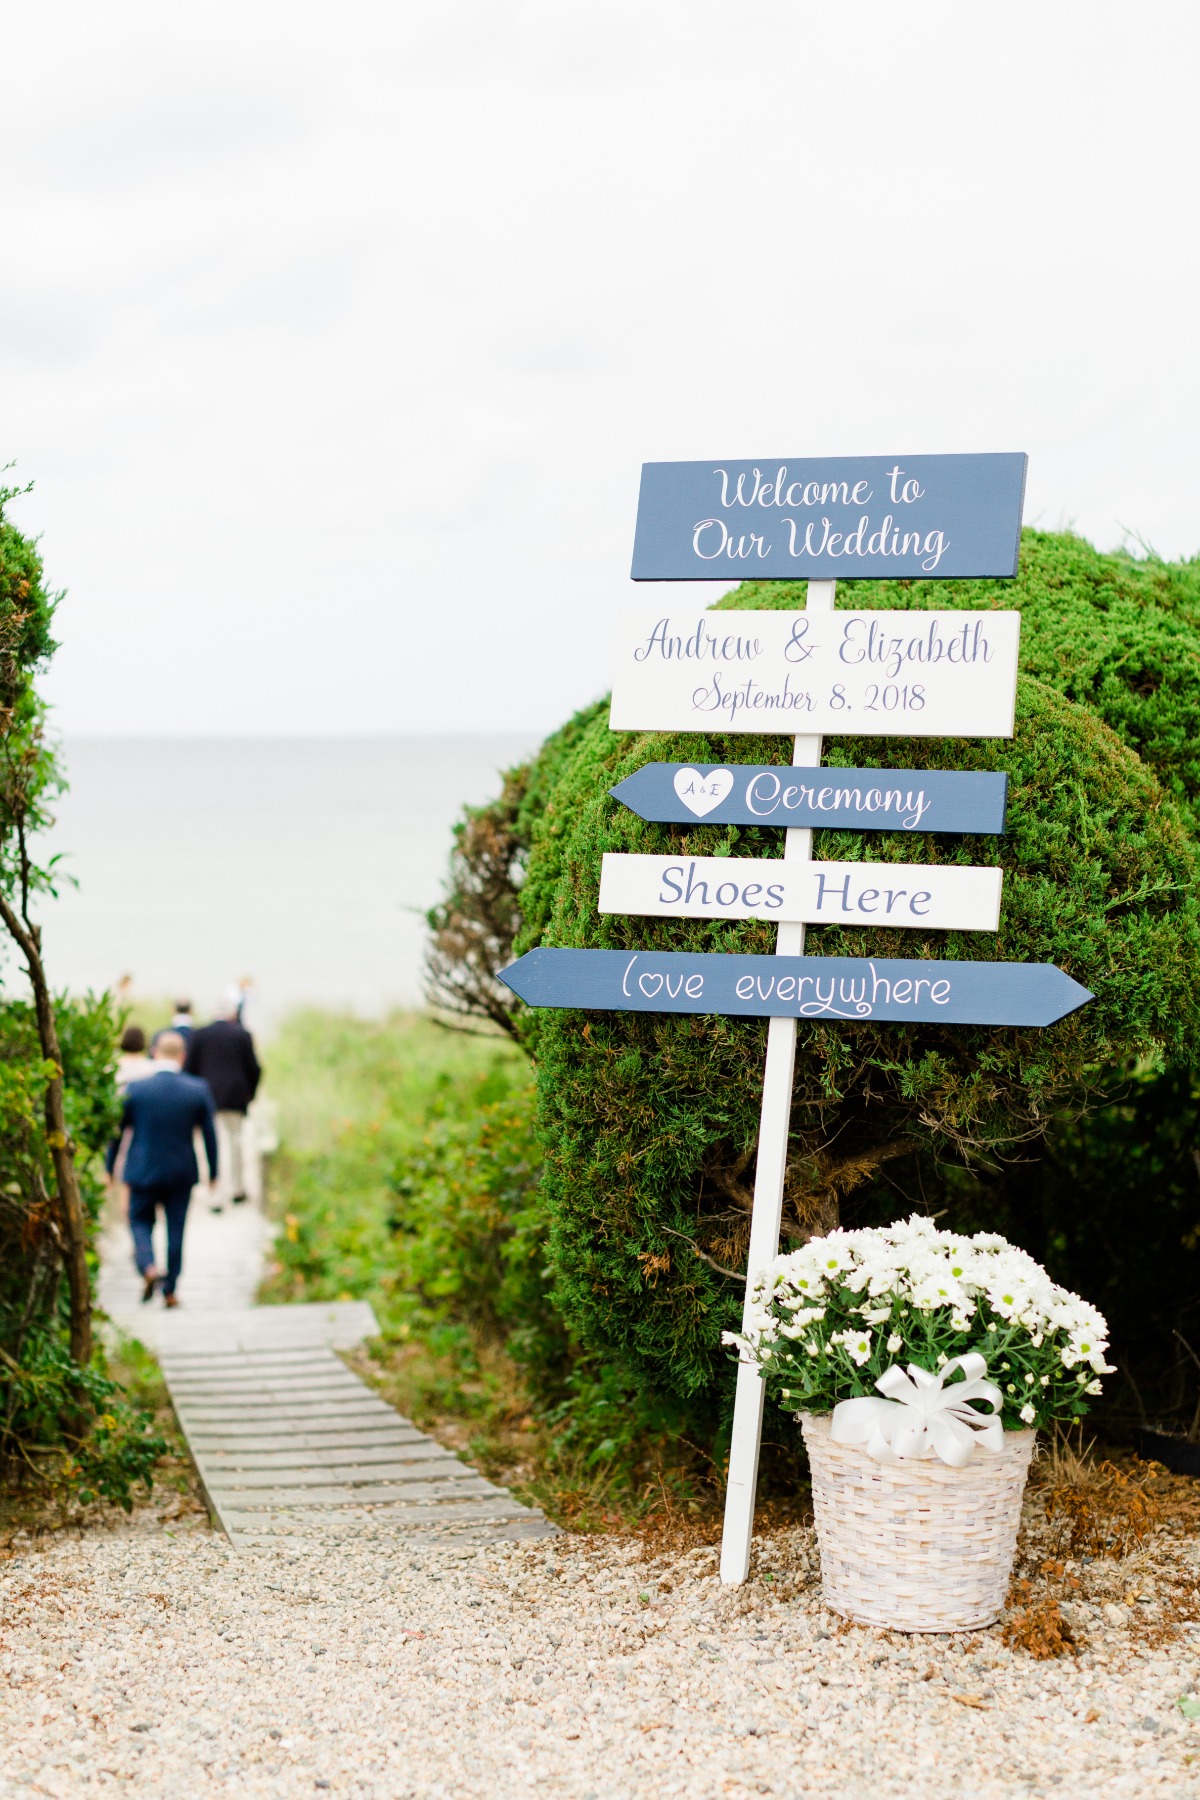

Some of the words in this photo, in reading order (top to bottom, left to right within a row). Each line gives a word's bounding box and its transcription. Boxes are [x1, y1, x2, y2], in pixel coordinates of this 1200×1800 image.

[713, 466, 873, 508] Welcome
[886, 465, 925, 504] to
[692, 518, 772, 559] Our
[781, 515, 950, 571] Wedding
[634, 618, 764, 662] Andrew
[784, 617, 820, 663] &
[839, 618, 995, 678] Elizabeth
[692, 671, 817, 722] September
[863, 683, 926, 711] 2018
[681, 781, 695, 795] A
[699, 784, 706, 794] &
[709, 783, 721, 796] E
[745, 772, 931, 830] Ceremony
[658, 862, 784, 909] Shoes
[813, 872, 932, 916] Here
[735, 962, 951, 1018] everywhere
